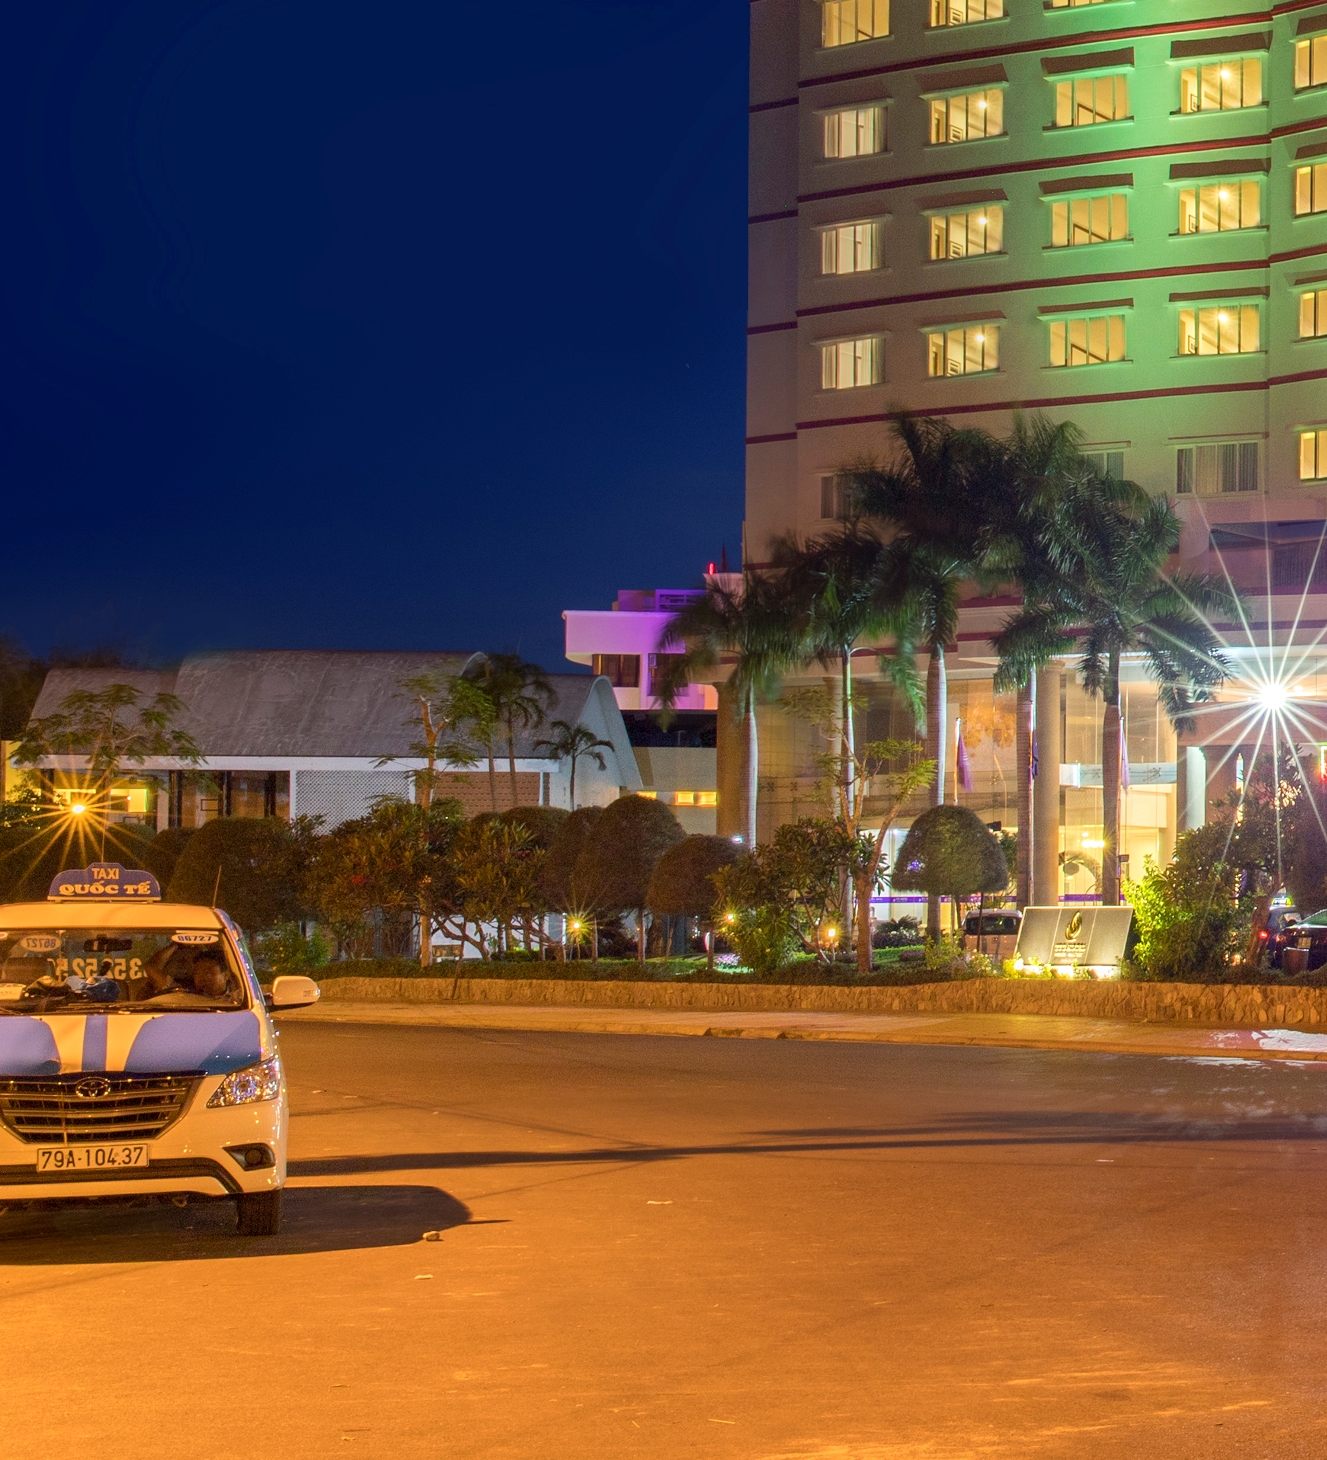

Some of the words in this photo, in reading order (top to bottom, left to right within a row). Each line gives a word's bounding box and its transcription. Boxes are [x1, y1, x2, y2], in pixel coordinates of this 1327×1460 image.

[91, 867, 119, 880] TAXI
[58, 880, 119, 896] QUỐC
[123, 880, 151, 895] TẾ
[41, 1146, 144, 1170] 79A-104.37
